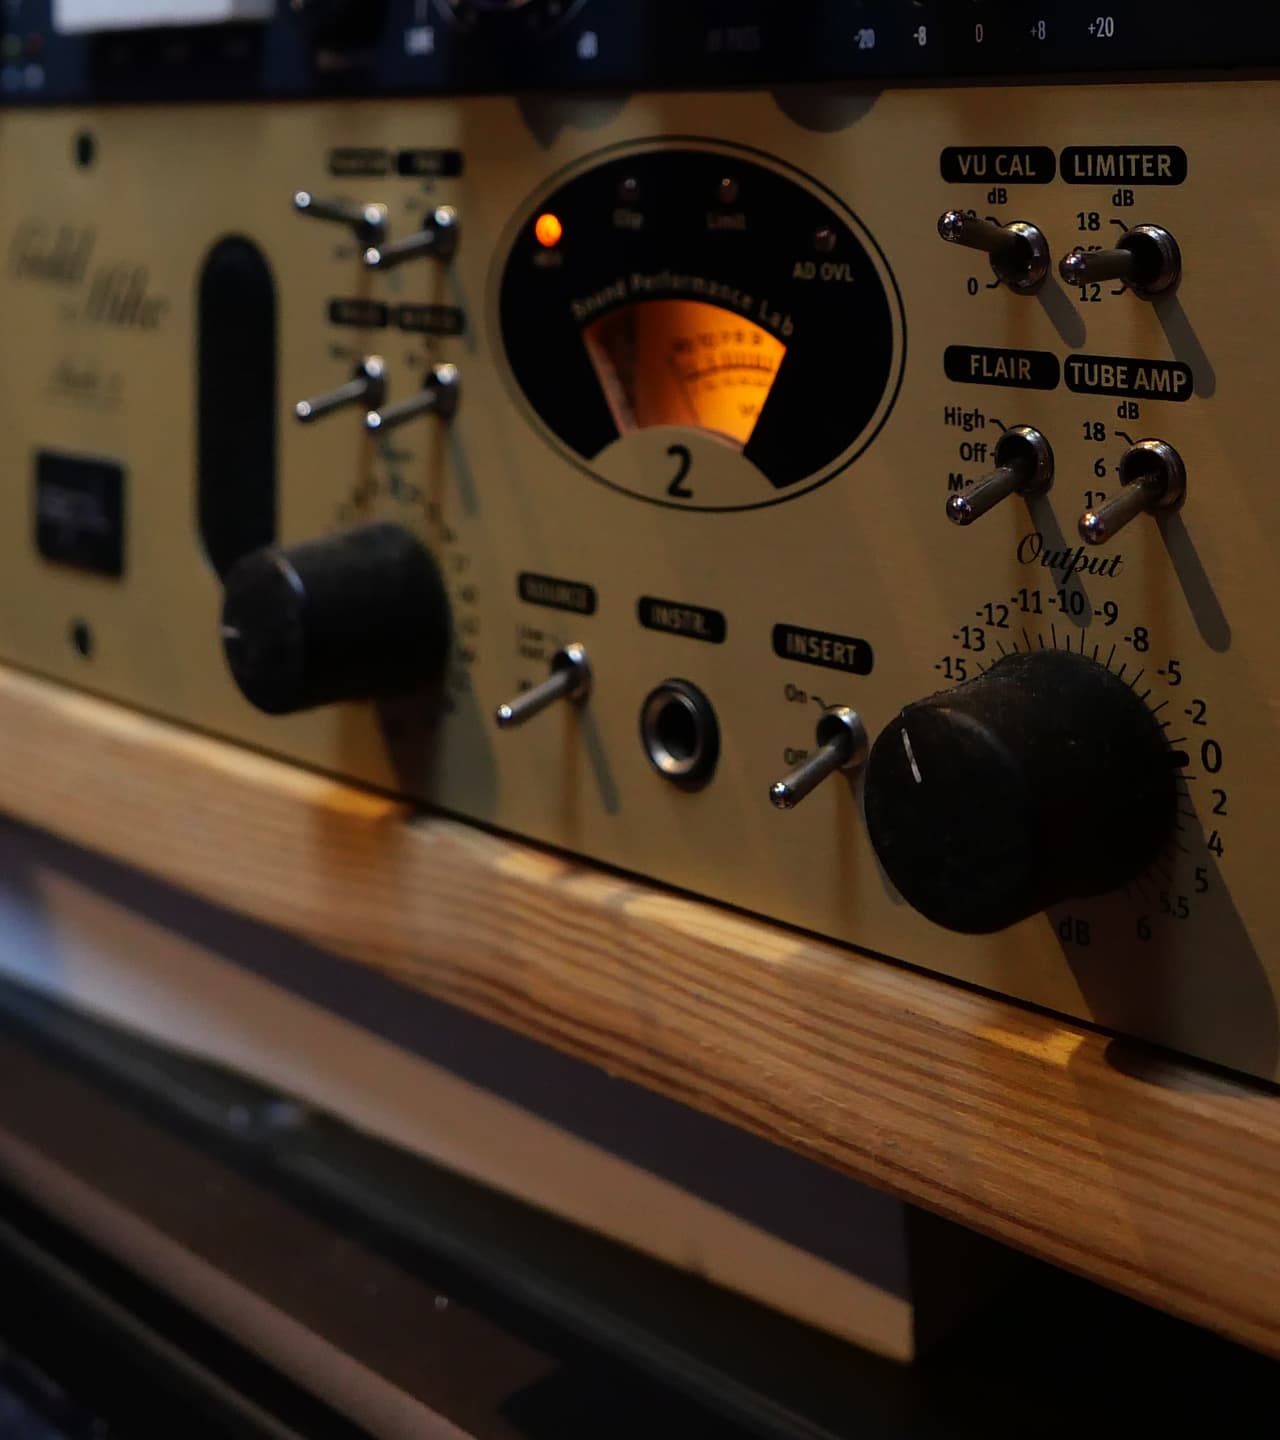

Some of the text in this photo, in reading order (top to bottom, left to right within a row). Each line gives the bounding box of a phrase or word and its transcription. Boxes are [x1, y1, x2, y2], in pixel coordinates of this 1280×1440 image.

[1029, 19, 1047, 41] +8
[1088, 16, 1115, 38] +20
[958, 154, 1036, 176] VU CAL
[1074, 154, 1173, 177] LIMITER
[987, 188, 1008, 205] dB
[1112, 189, 1135, 207] dB
[1077, 212, 1101, 231] 18
[792, 261, 855, 283] AD OVL
[967, 278, 978, 296] 0
[1079, 283, 1102, 303] 12
[759, 298, 796, 337] Lab
[970, 355, 1032, 380] FLAIR
[1070, 362, 1188, 394] TUBE AMP
[944, 406, 985, 432] High
[1117, 400, 1140, 420] dB
[1083, 421, 1106, 441] 18
[959, 442, 988, 463] Off
[666, 444, 694, 499] 2
[1094, 458, 1107, 478] 6
[1017, 532, 1124, 584] Output
[1010, 589, 1043, 614] -11
[1048, 590, 1085, 616] -10
[1094, 601, 1119, 626] -9
[975, 604, 1010, 629] -12
[786, 632, 857, 666] INSERT
[952, 625, 986, 652] -13
[1124, 627, 1150, 653] -8
[934, 656, 968, 681] -15
[1157, 660, 1182, 686] -5
[784, 683, 808, 704] On
[1184, 699, 1207, 726] -2
[1200, 739, 1223, 773] 0
[1211, 789, 1228, 816] 2
[1207, 830, 1224, 857] 4
[1194, 867, 1209, 893] 5
[1159, 891, 1190, 920] 5.5
[1058, 914, 1091, 946] dB
[1136, 914, 1153, 942] 6
